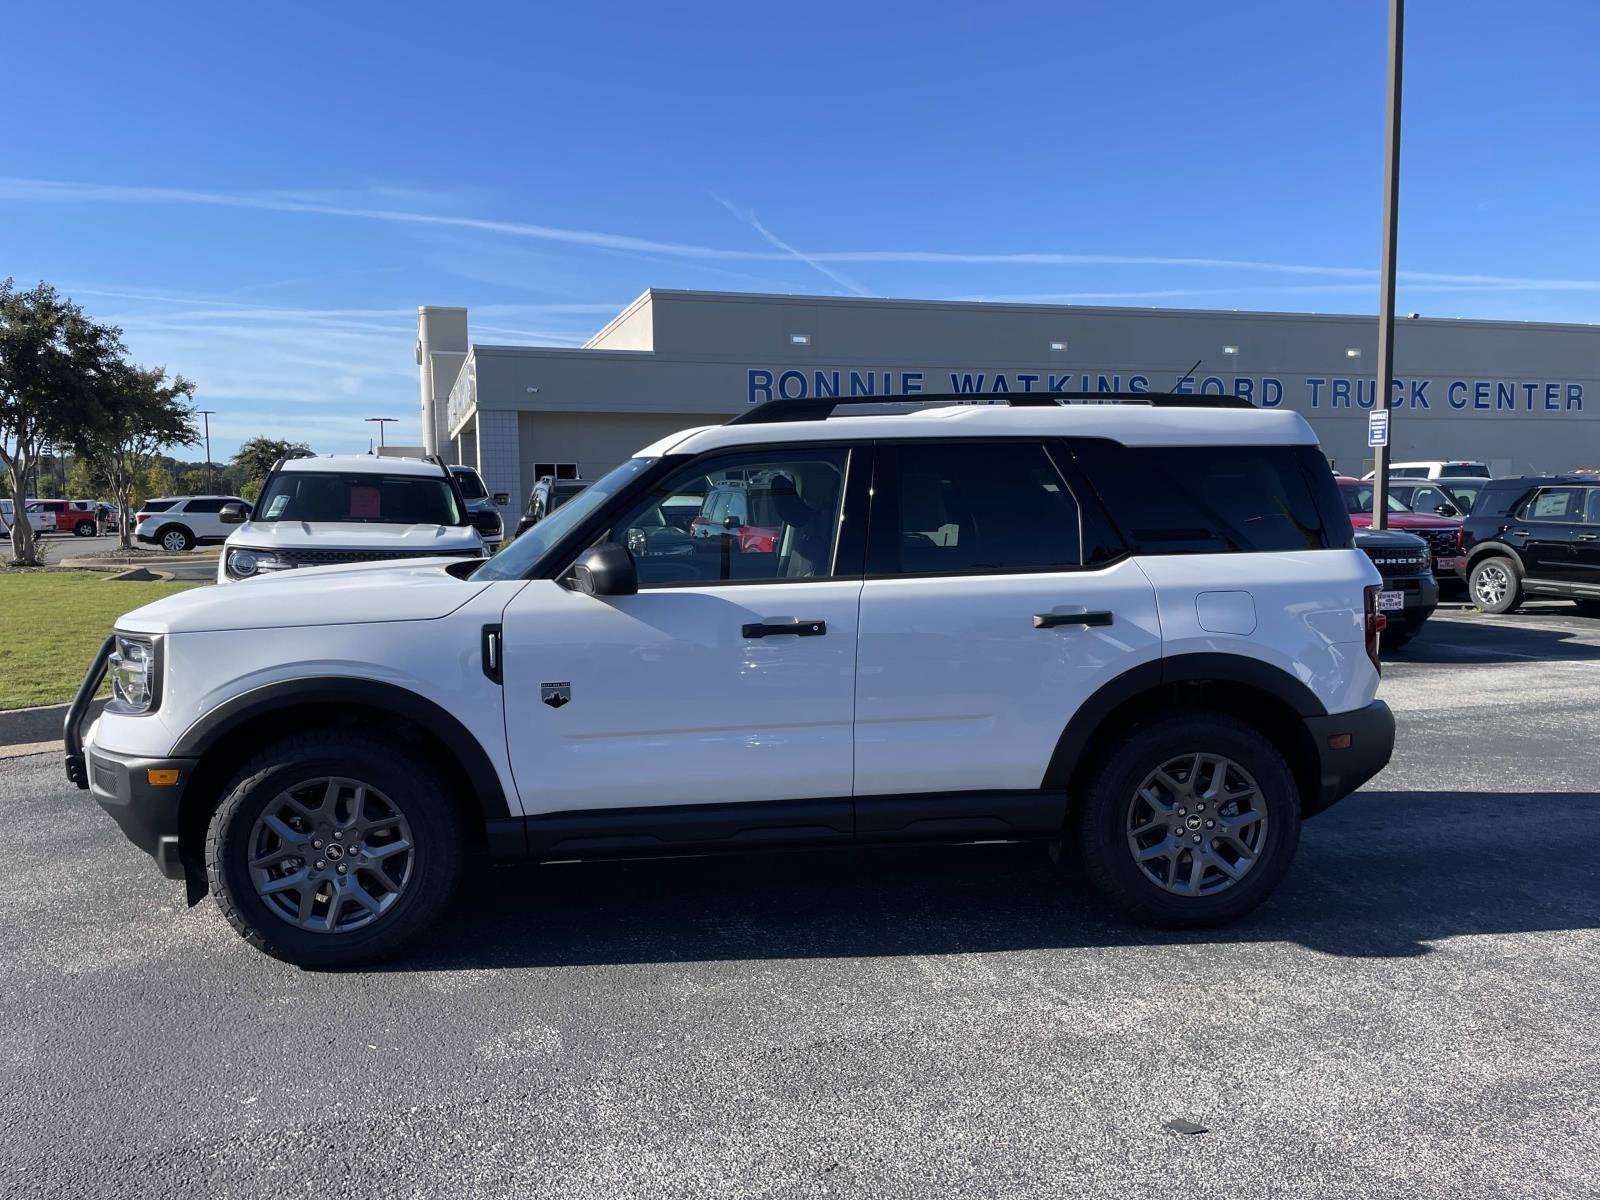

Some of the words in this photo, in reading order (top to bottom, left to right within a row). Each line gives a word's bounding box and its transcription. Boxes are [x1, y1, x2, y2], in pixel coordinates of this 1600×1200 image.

[747, 368, 924, 404] RONNIE
[950, 373, 1151, 404] WATKINS
[1176, 376, 1283, 408] FORD
[1306, 378, 1431, 410] TRUCK
[1448, 381, 1584, 412] CENTER
